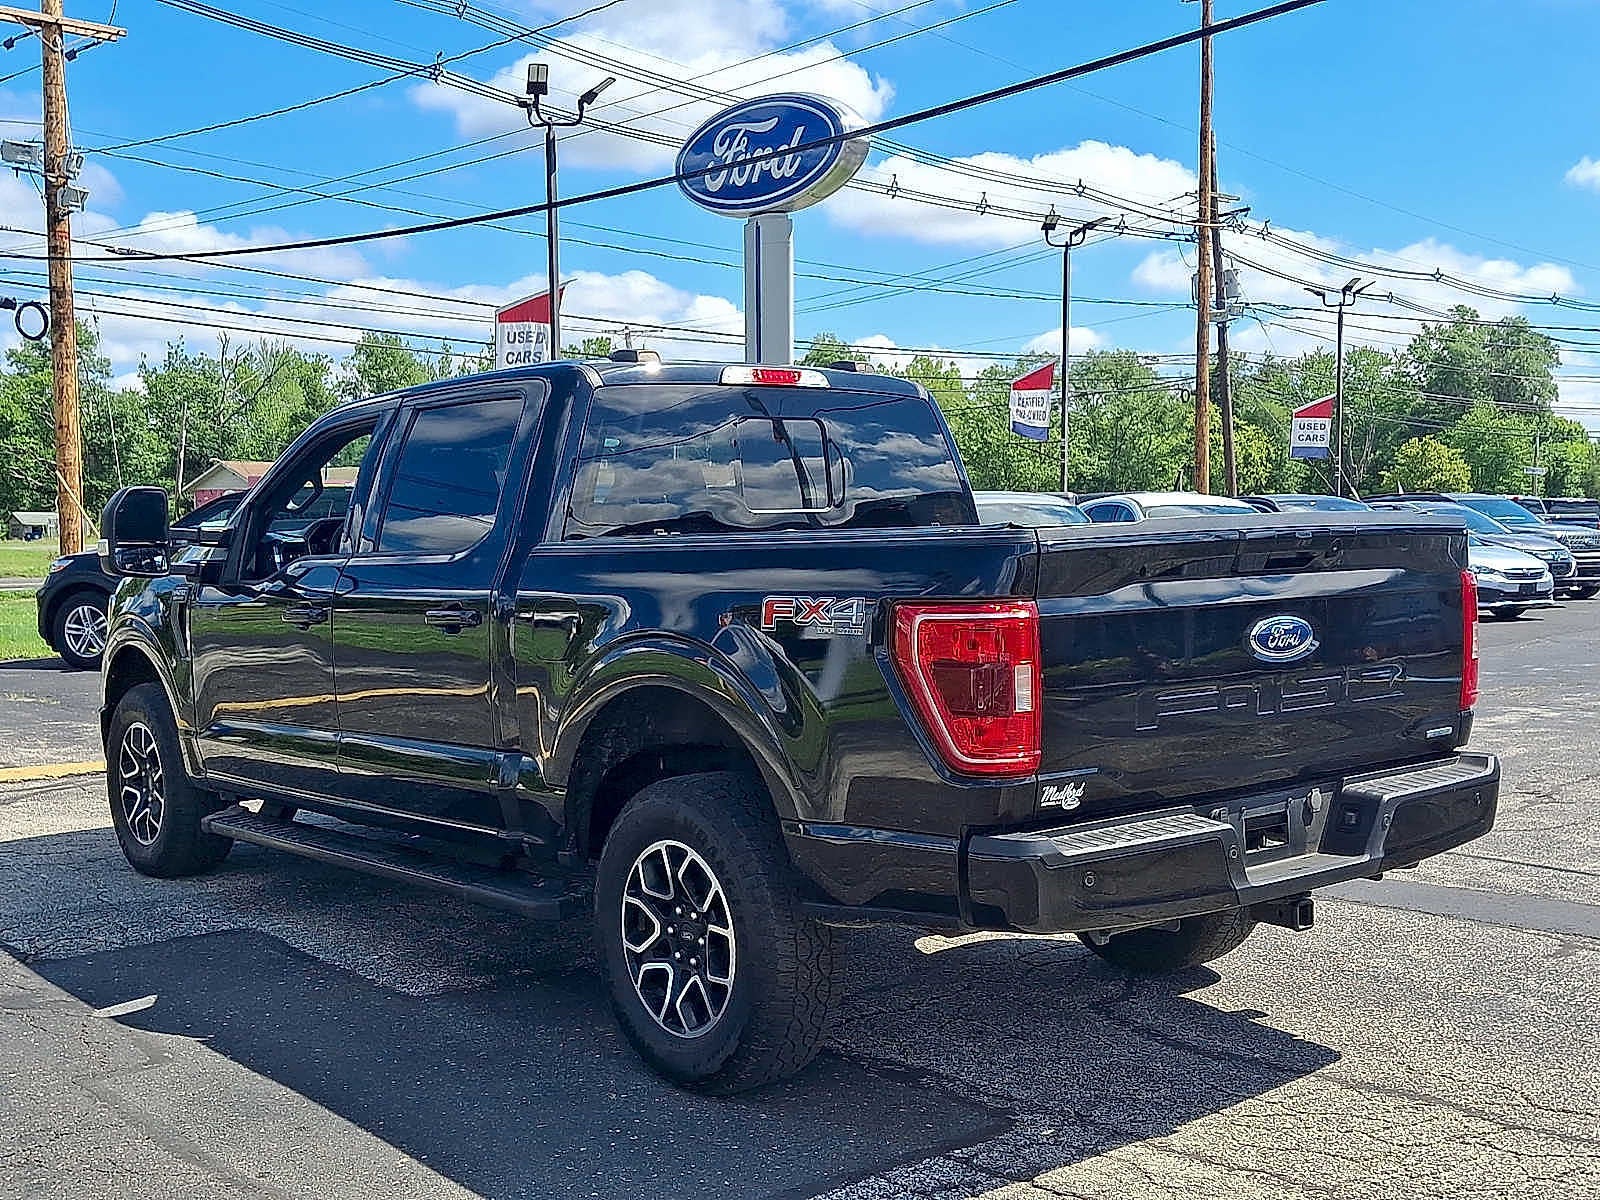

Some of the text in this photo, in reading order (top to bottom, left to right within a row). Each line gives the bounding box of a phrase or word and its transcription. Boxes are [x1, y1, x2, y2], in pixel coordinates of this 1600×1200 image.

[705, 116, 806, 192] Ford
[506, 331, 546, 345] USED
[505, 350, 542, 365] CARS
[1017, 396, 1045, 408] CERTIFIED
[1298, 422, 1327, 431] USED
[1297, 433, 1326, 442] CARS
[761, 595, 866, 631] FX4
[1267, 623, 1301, 649] Ford
[1040, 781, 1087, 803] Medford
